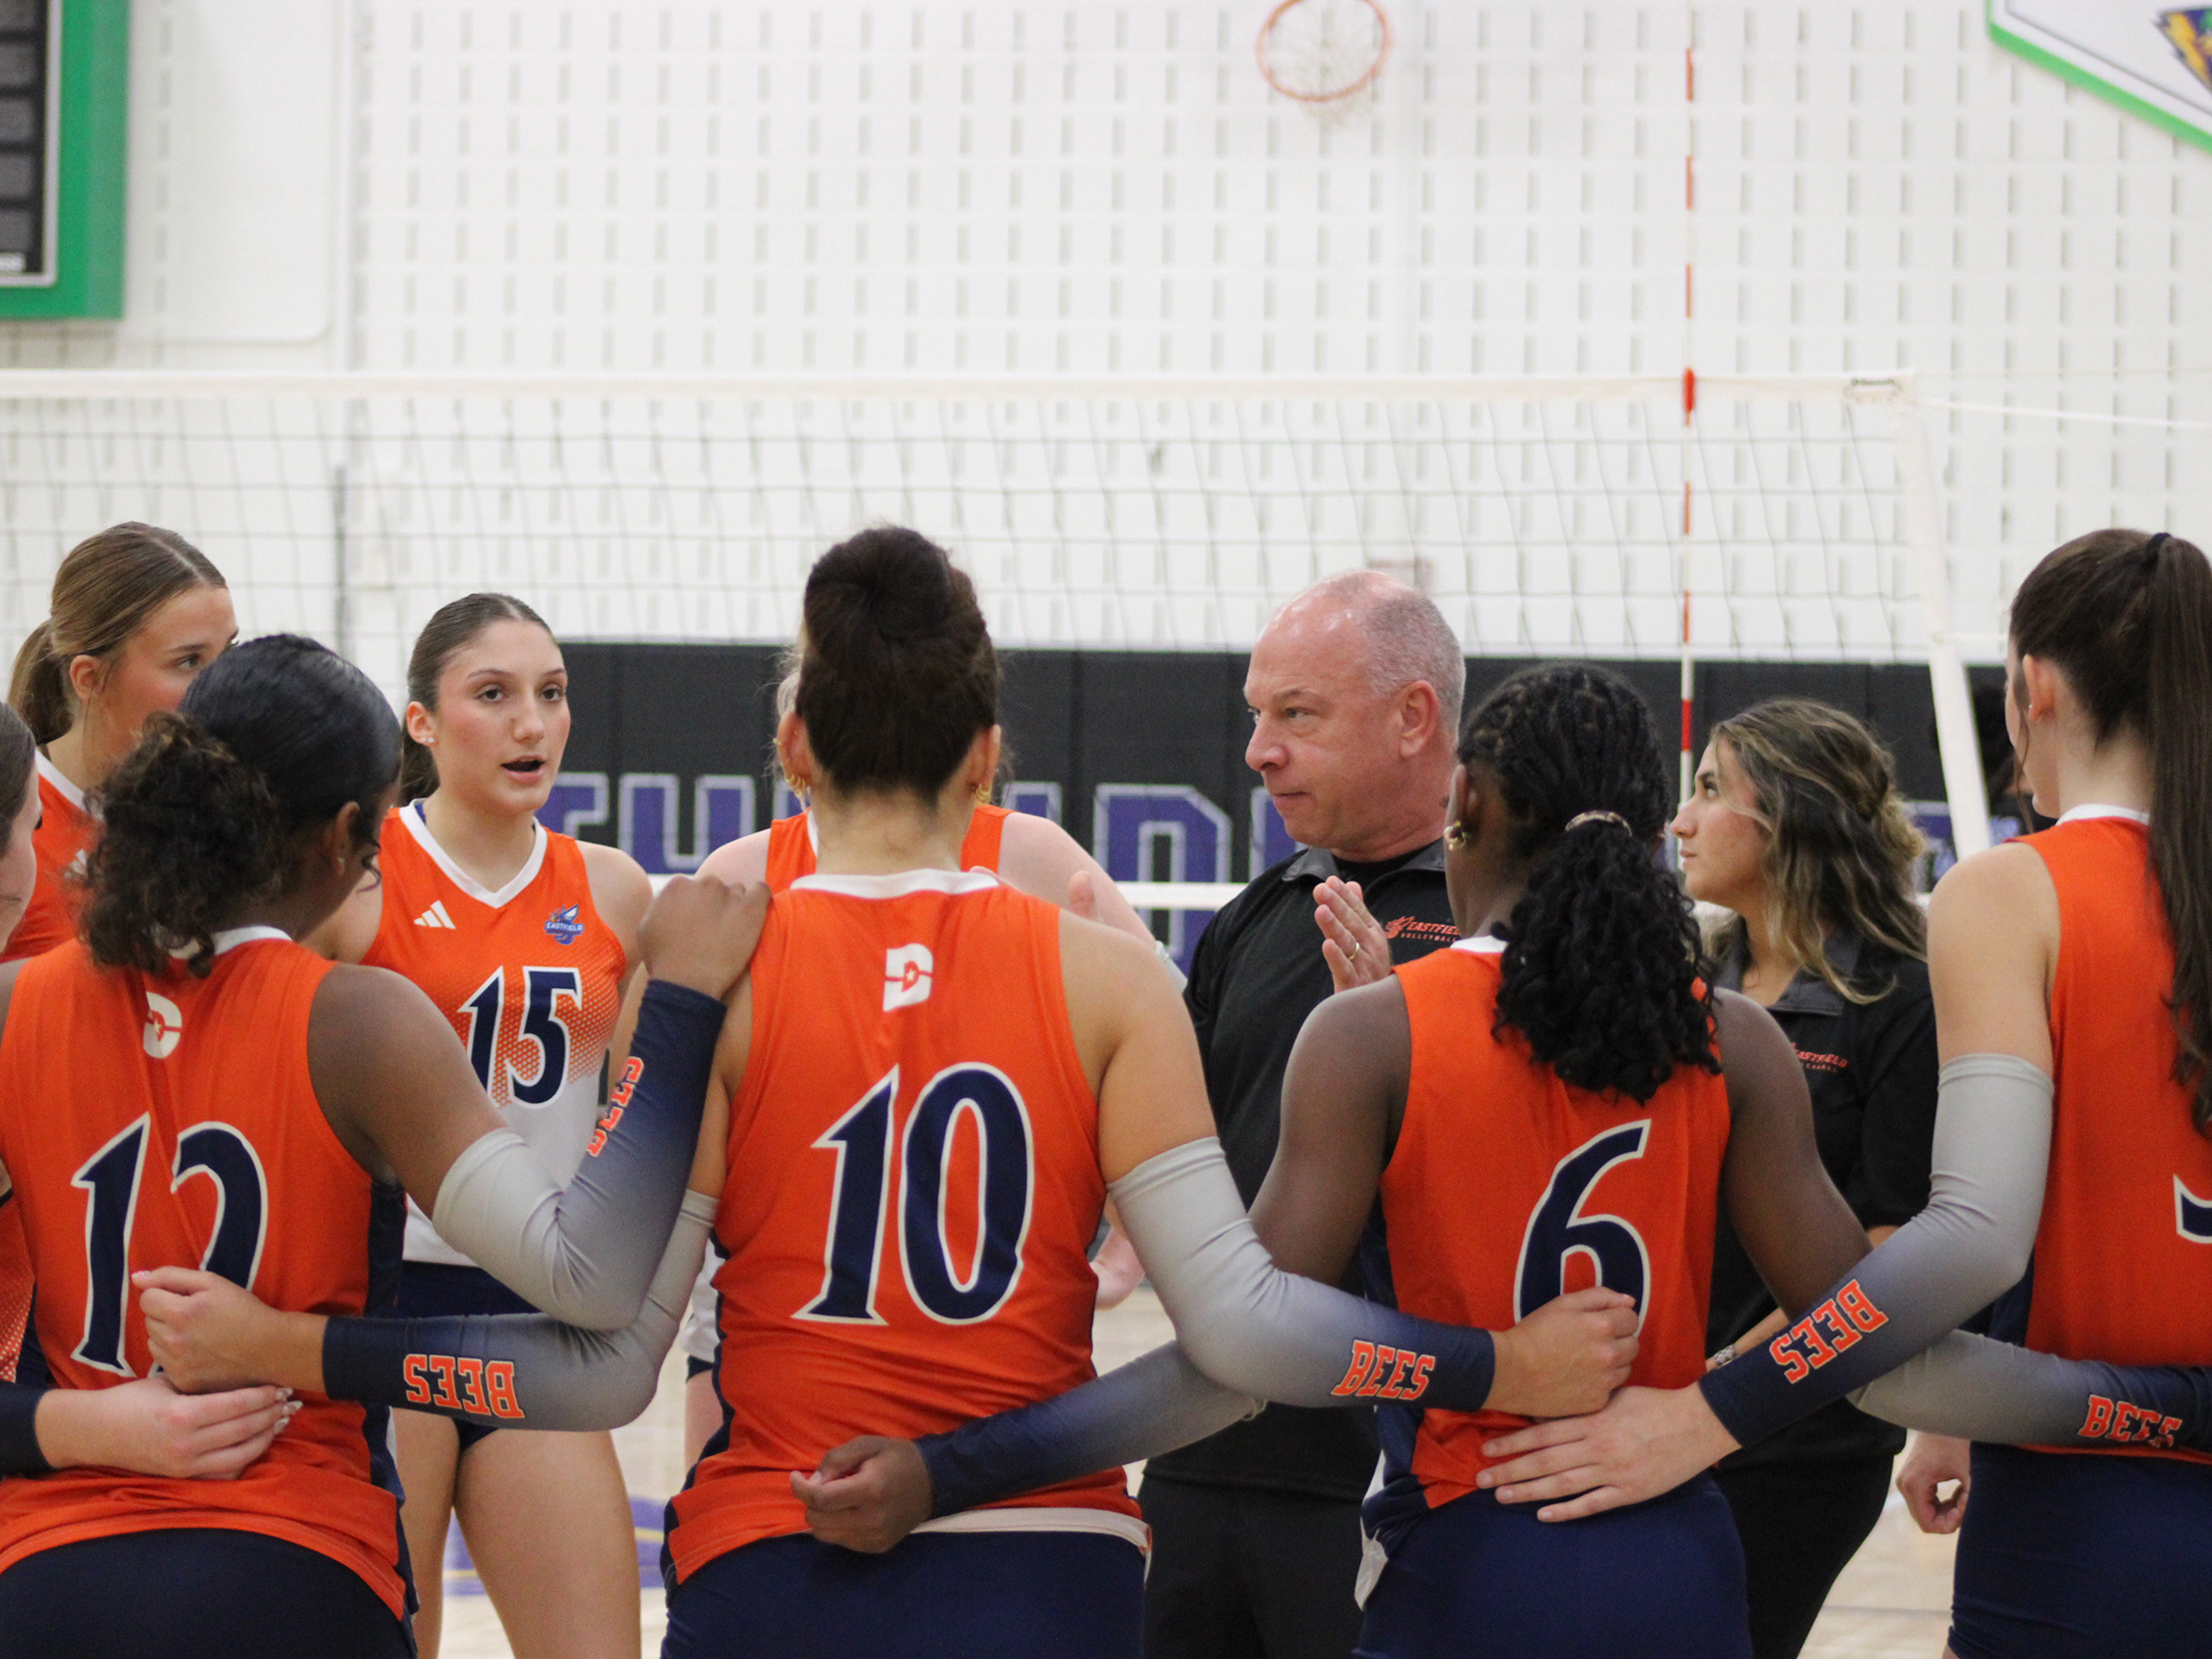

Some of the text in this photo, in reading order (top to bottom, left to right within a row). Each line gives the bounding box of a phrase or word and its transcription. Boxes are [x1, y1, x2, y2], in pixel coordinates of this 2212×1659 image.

[456, 965, 583, 1110] 15
[791, 1062, 1035, 1326] 10
[1512, 1118, 1652, 1338] 6
[403, 1354, 526, 1418] BEES
[1331, 1340, 1435, 1400] BEES
[1769, 1279, 1889, 1384] BEES
